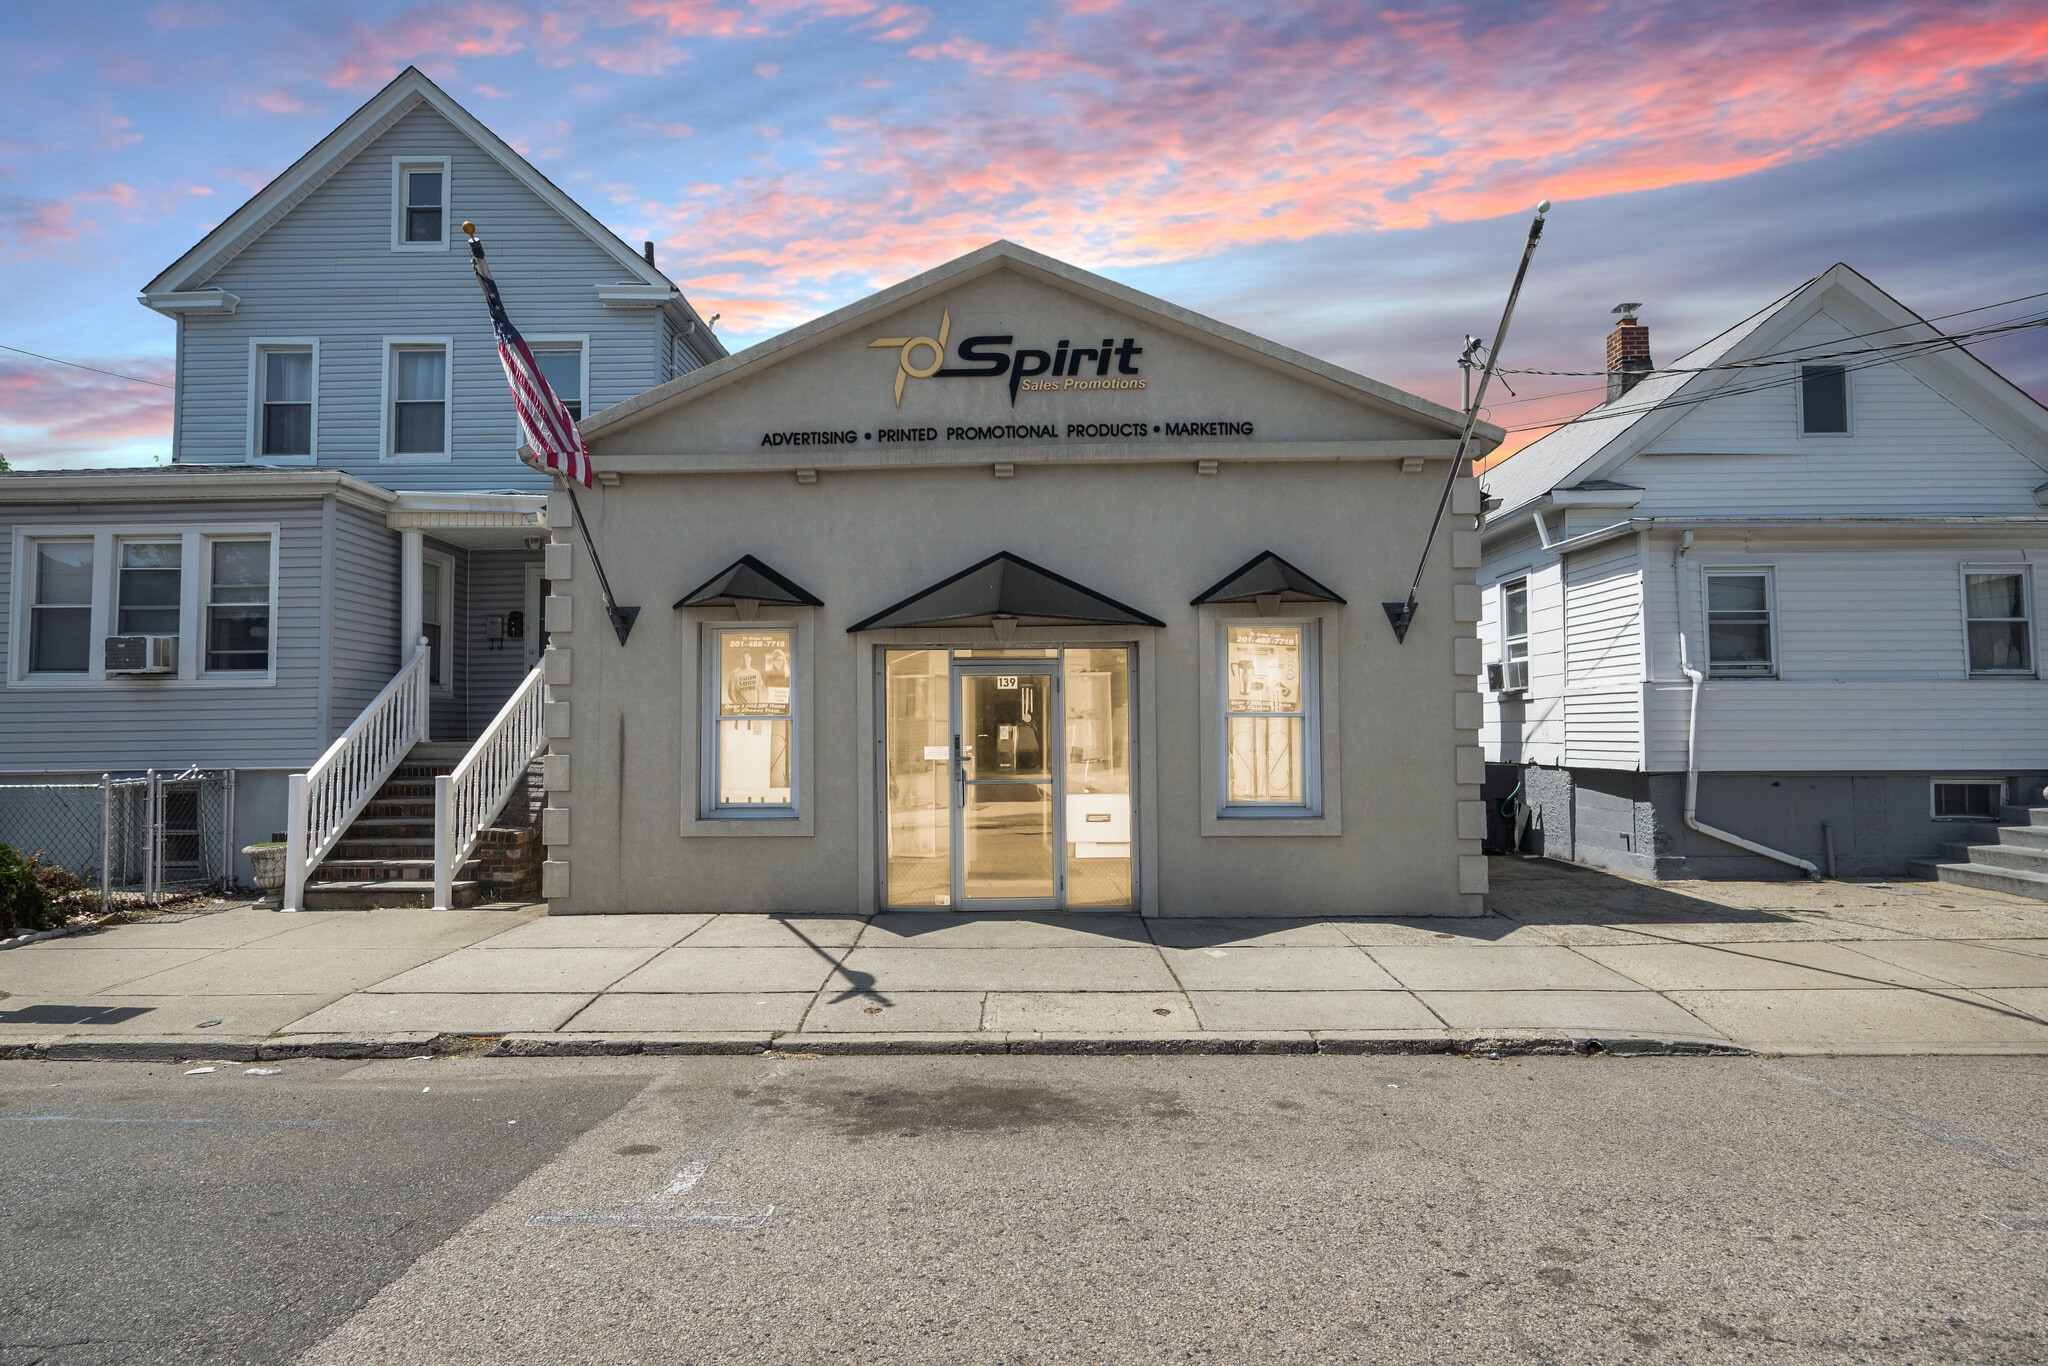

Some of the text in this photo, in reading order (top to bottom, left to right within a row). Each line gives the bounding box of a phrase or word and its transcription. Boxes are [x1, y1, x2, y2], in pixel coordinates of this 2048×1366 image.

[933, 335, 1143, 408] Spirit
[1021, 377, 1146, 391] Sales Promotions
[761, 421, 1254, 447] ADVERTISING PRINTED PROMOTIONAL PRODUCTS MARKETING
[729, 640, 785, 648] 201-488-7718
[1236, 636, 1295, 646] 201-488-7718
[999, 677, 1016, 687] 139
